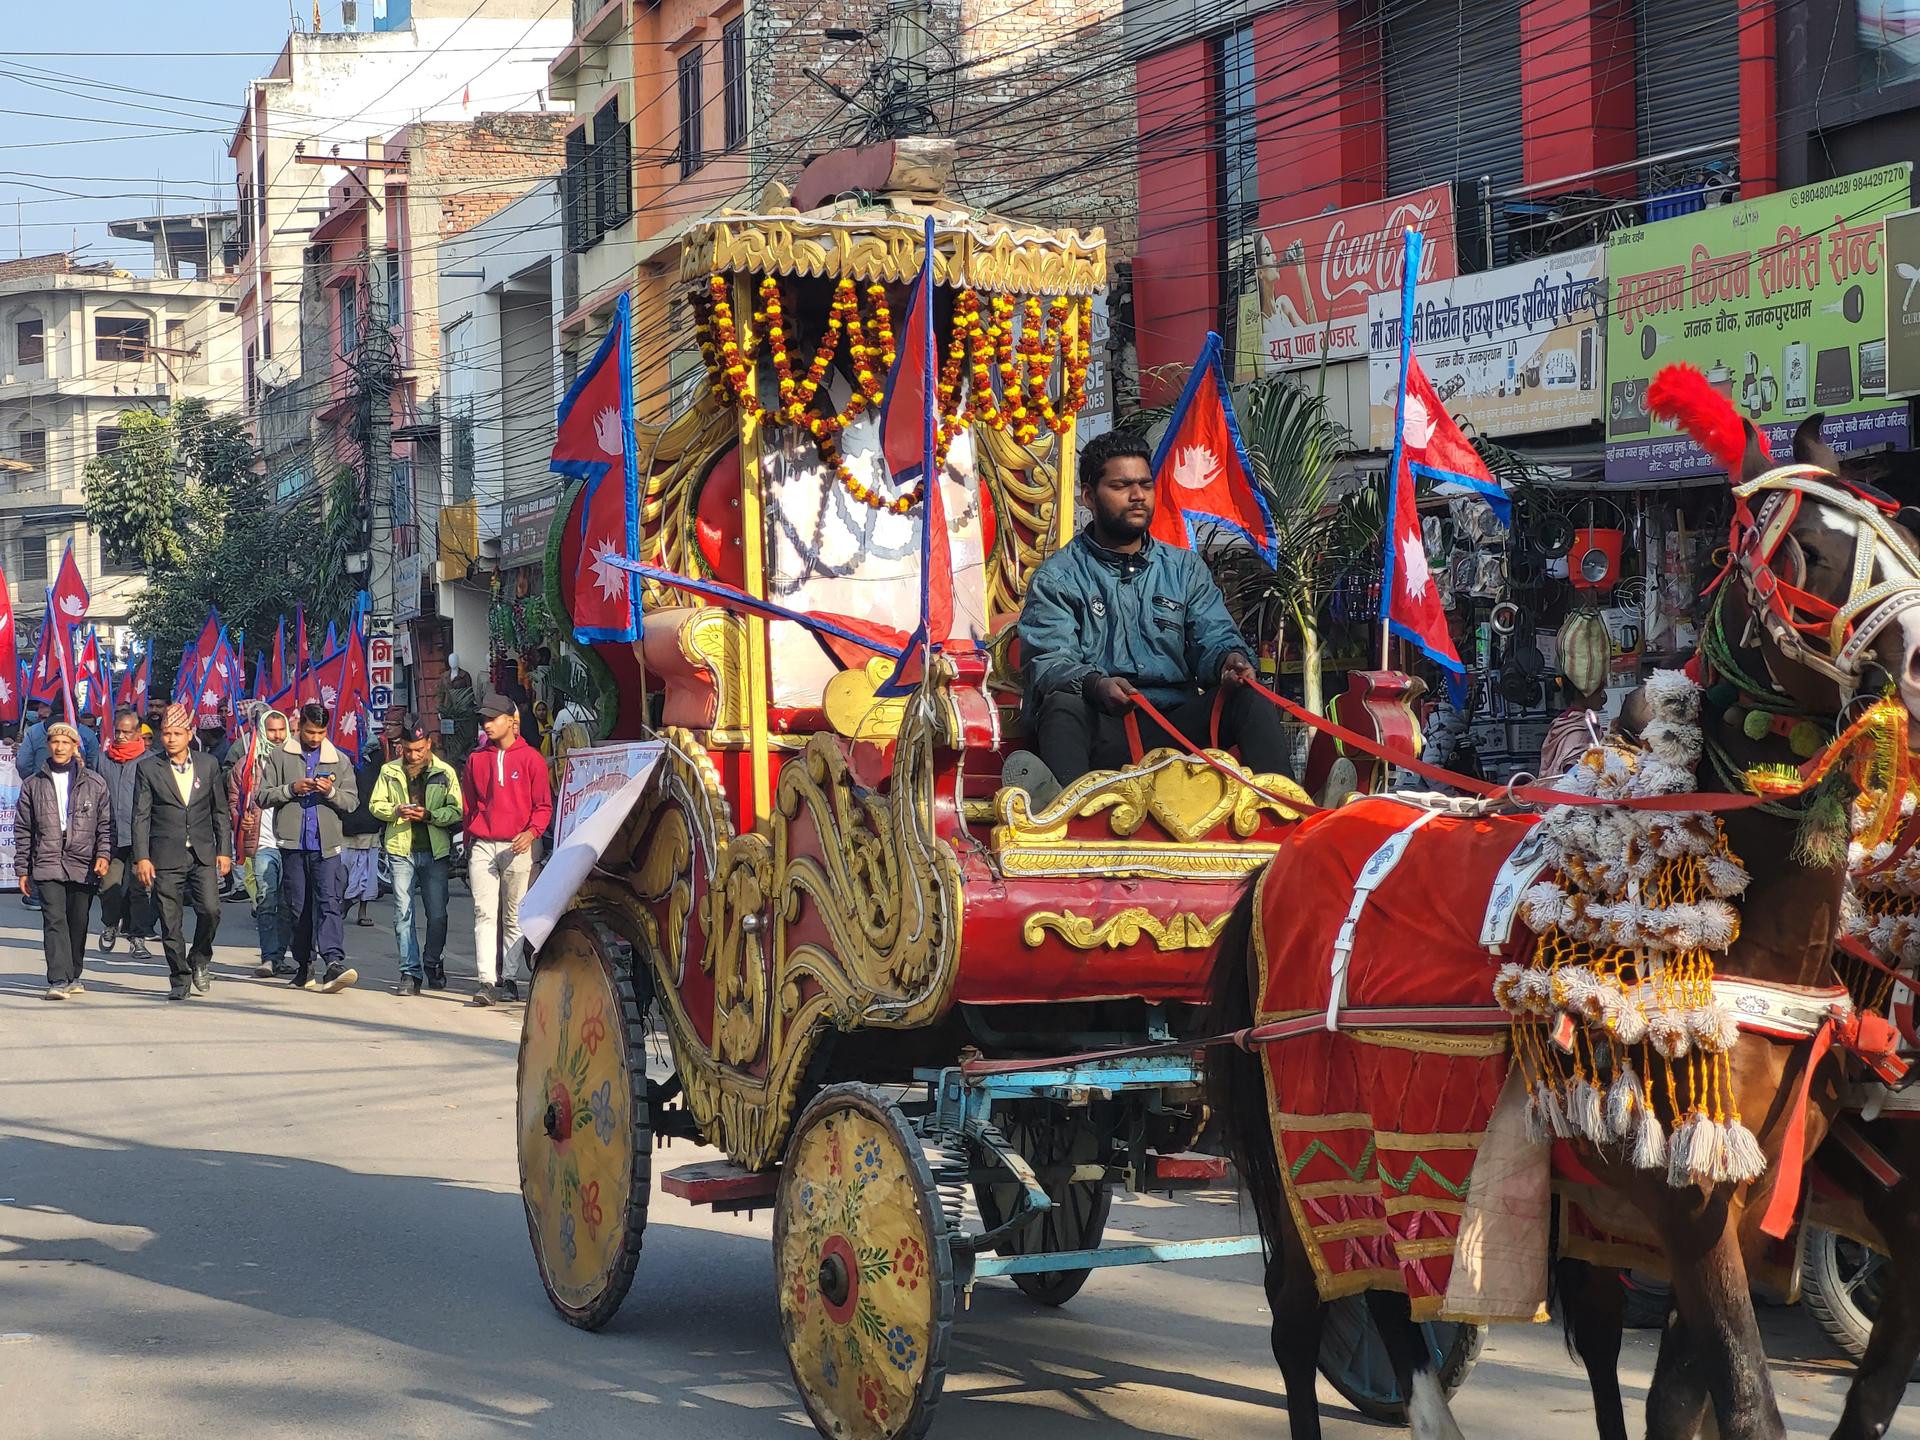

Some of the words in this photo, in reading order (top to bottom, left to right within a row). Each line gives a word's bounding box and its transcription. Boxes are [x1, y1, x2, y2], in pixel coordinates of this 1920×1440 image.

[1617, 264, 1686, 335] मुस्कान
[1691, 244, 1752, 308] किचन
[1828, 215, 1884, 286] सेन्ट
[1385, 302, 1424, 347] जाकी
[1426, 297, 1461, 341] किचेन
[1463, 301, 1494, 342] हाउस
[1684, 317, 1712, 338] जनक
[1716, 308, 1740, 332] चौक,
[1745, 299, 1812, 330] जनकपुरधाम
[1295, 333, 1316, 356] पान
